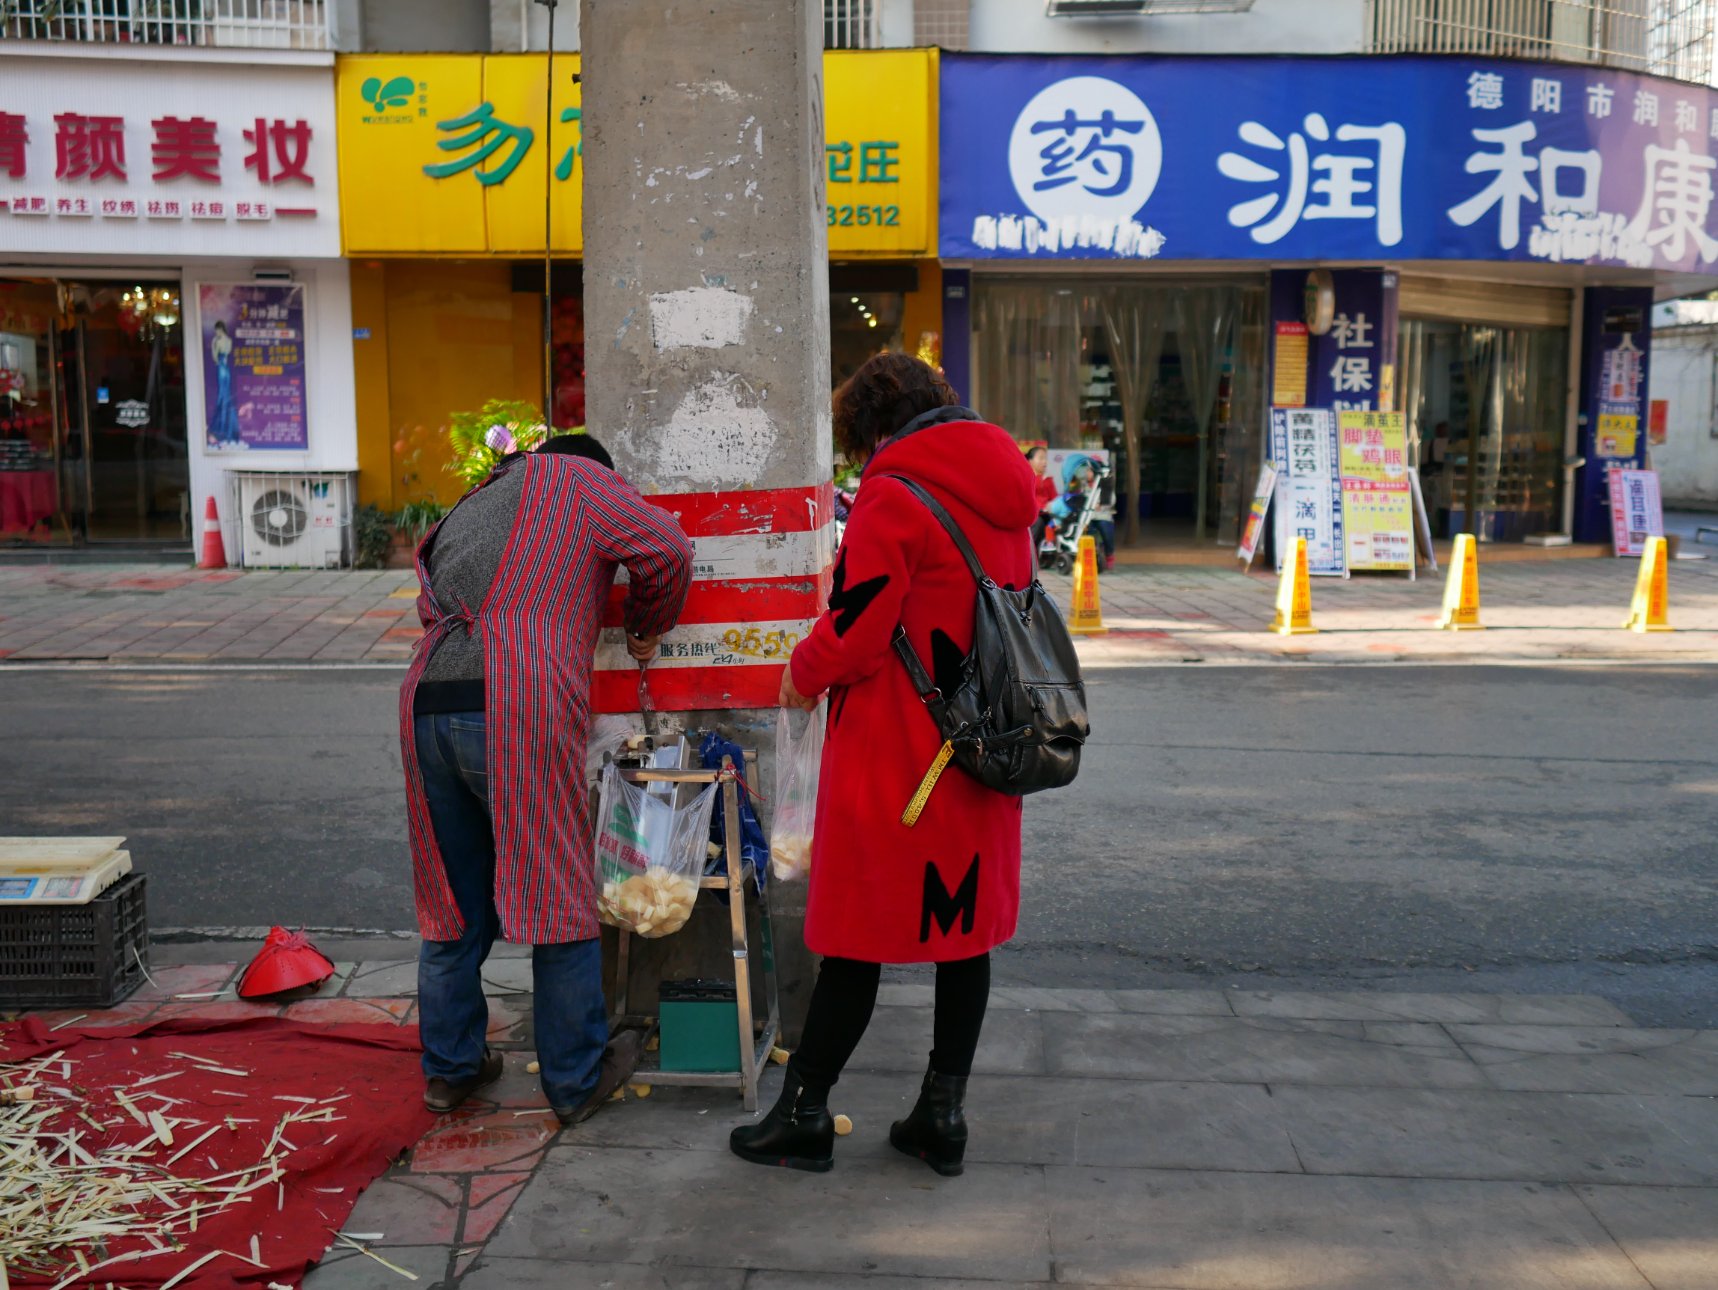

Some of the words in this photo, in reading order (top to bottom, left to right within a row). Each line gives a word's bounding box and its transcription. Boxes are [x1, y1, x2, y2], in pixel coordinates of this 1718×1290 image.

[1030, 108, 1147, 198] 药
[660, 643, 717, 657] 服务热线
